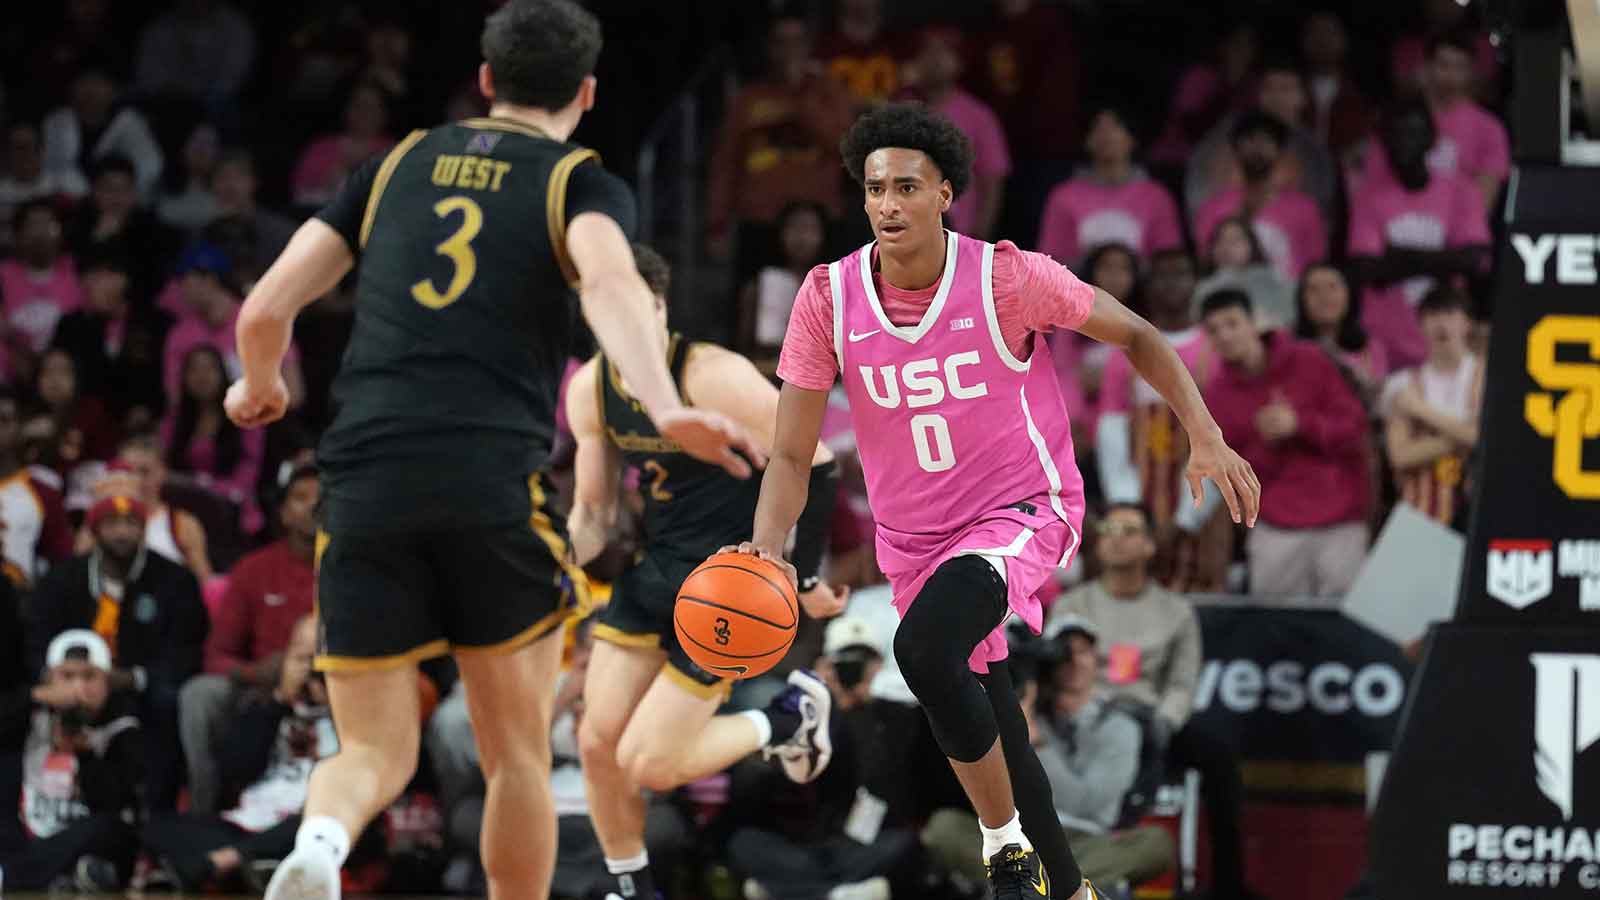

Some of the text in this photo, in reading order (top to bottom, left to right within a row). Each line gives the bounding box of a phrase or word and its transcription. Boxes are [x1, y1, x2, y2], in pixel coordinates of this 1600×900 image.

[431, 153, 512, 192] WEST
[410, 196, 483, 309] 3
[1511, 233, 1600, 284] YE
[859, 350, 989, 409] USC
[910, 414, 957, 473] 0
[643, 459, 673, 501] 2
[1448, 824, 1600, 863] PECHA
[1448, 860, 1563, 888] RESORT
